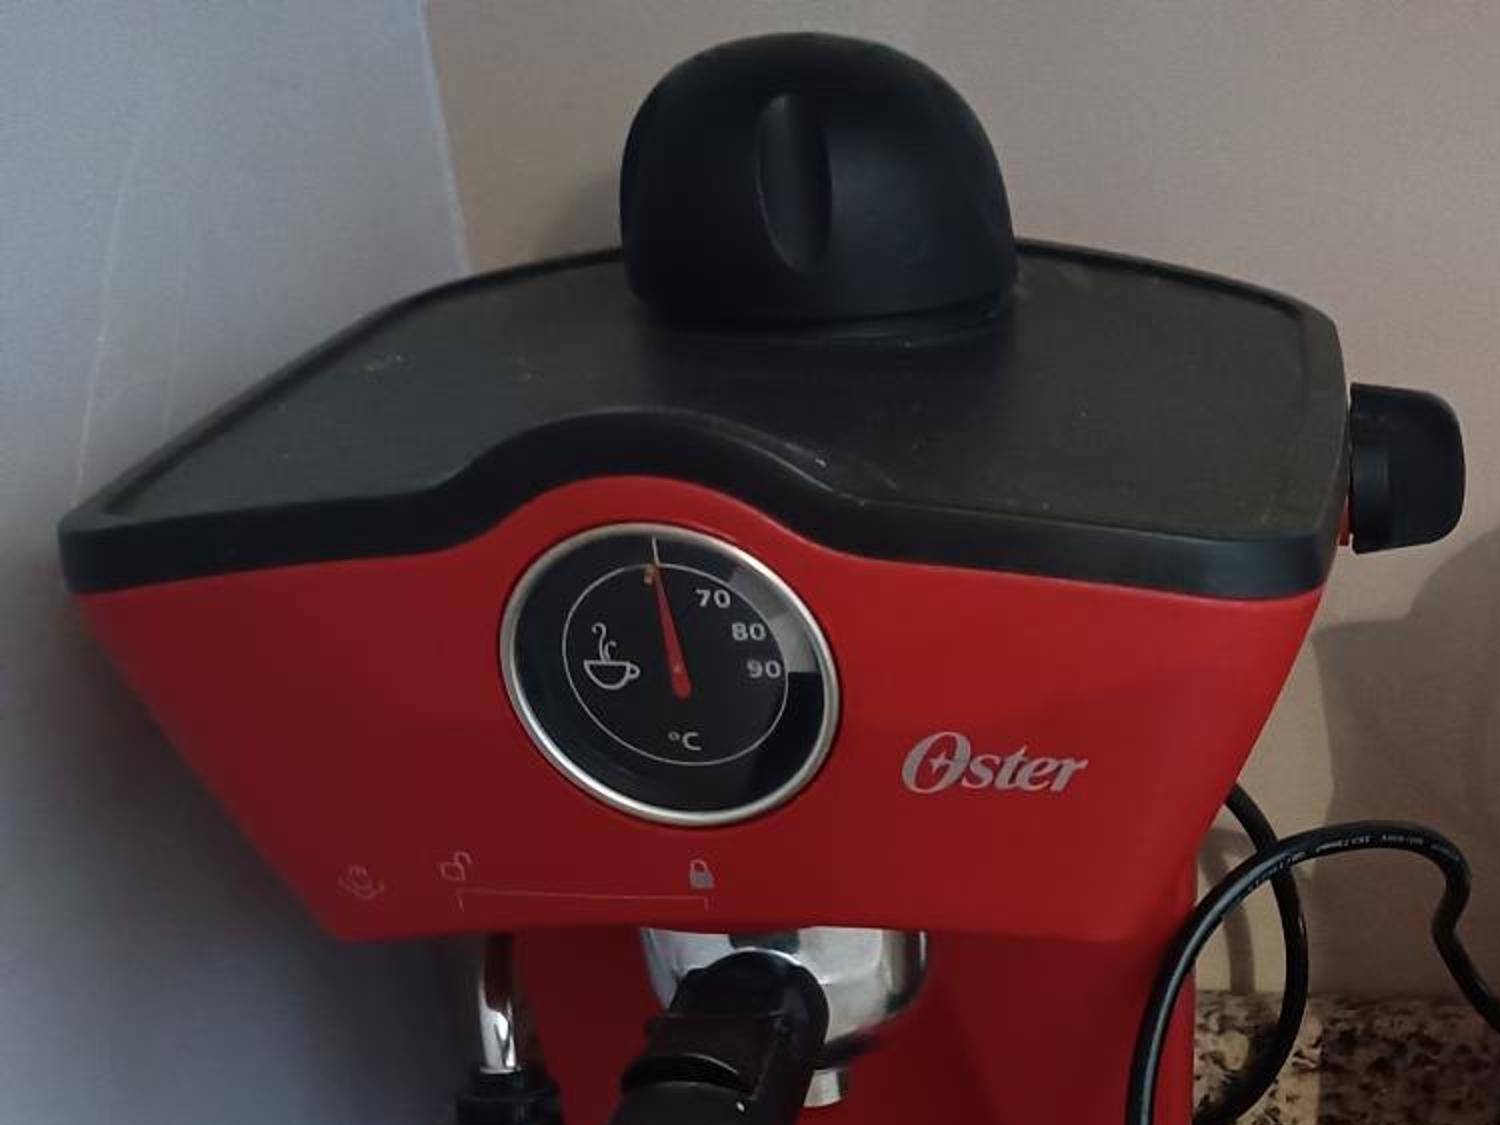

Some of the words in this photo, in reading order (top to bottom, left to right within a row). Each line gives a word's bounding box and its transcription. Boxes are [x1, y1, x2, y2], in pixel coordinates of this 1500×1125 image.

[696, 589, 731, 609] 70
[731, 622, 766, 641] 80
[747, 660, 782, 679] 90
[902, 731, 1089, 793] Oster
